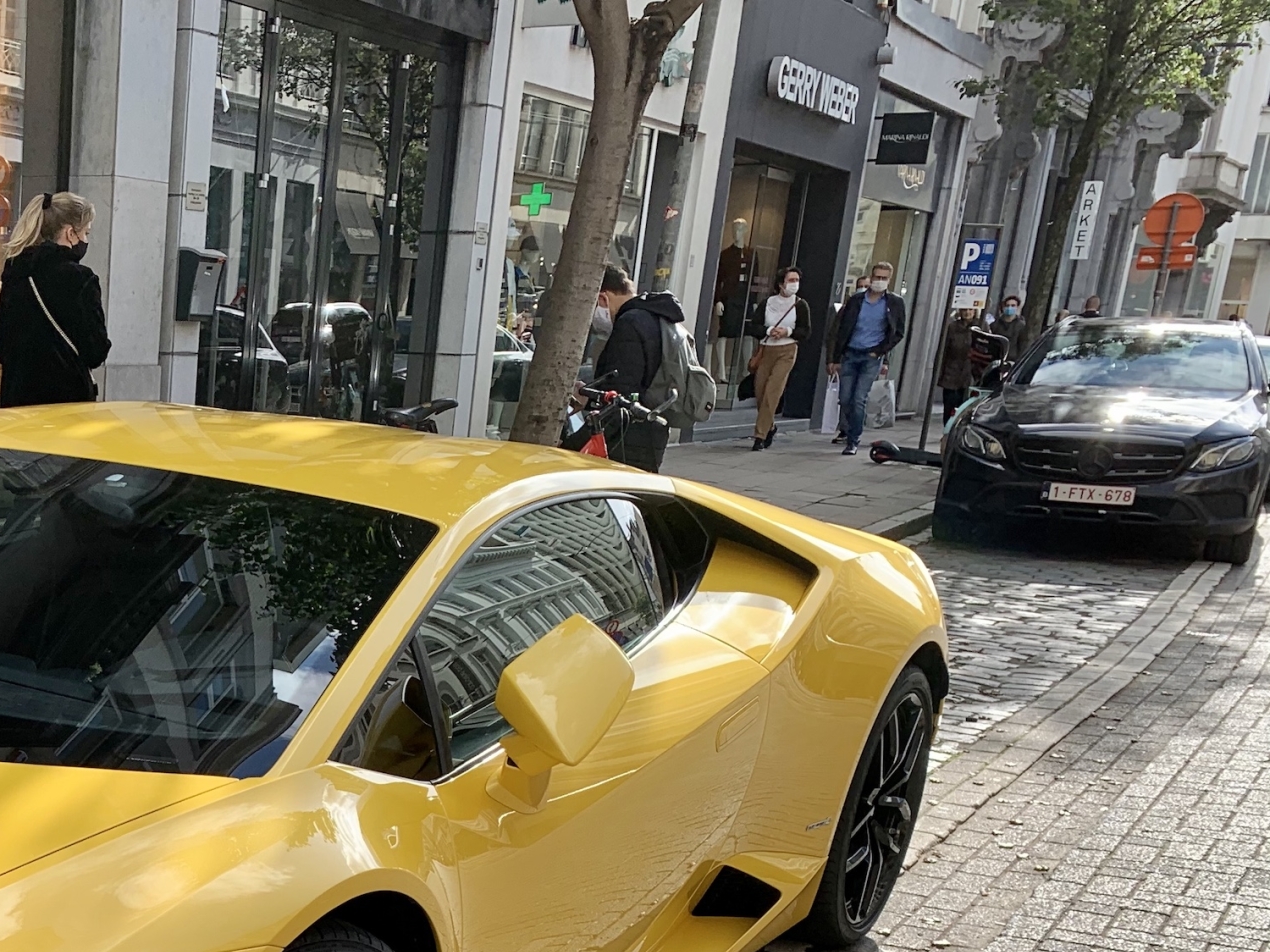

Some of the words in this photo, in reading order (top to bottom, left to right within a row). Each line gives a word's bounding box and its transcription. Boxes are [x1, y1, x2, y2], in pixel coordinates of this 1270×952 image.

[778, 55, 822, 109] GERRY
[819, 72, 860, 125] WEBER
[1074, 183, 1097, 257] ARKET
[960, 243, 981, 270] P
[958, 274, 988, 285] AN091
[1053, 486, 1132, 502] 1-FTX-678
